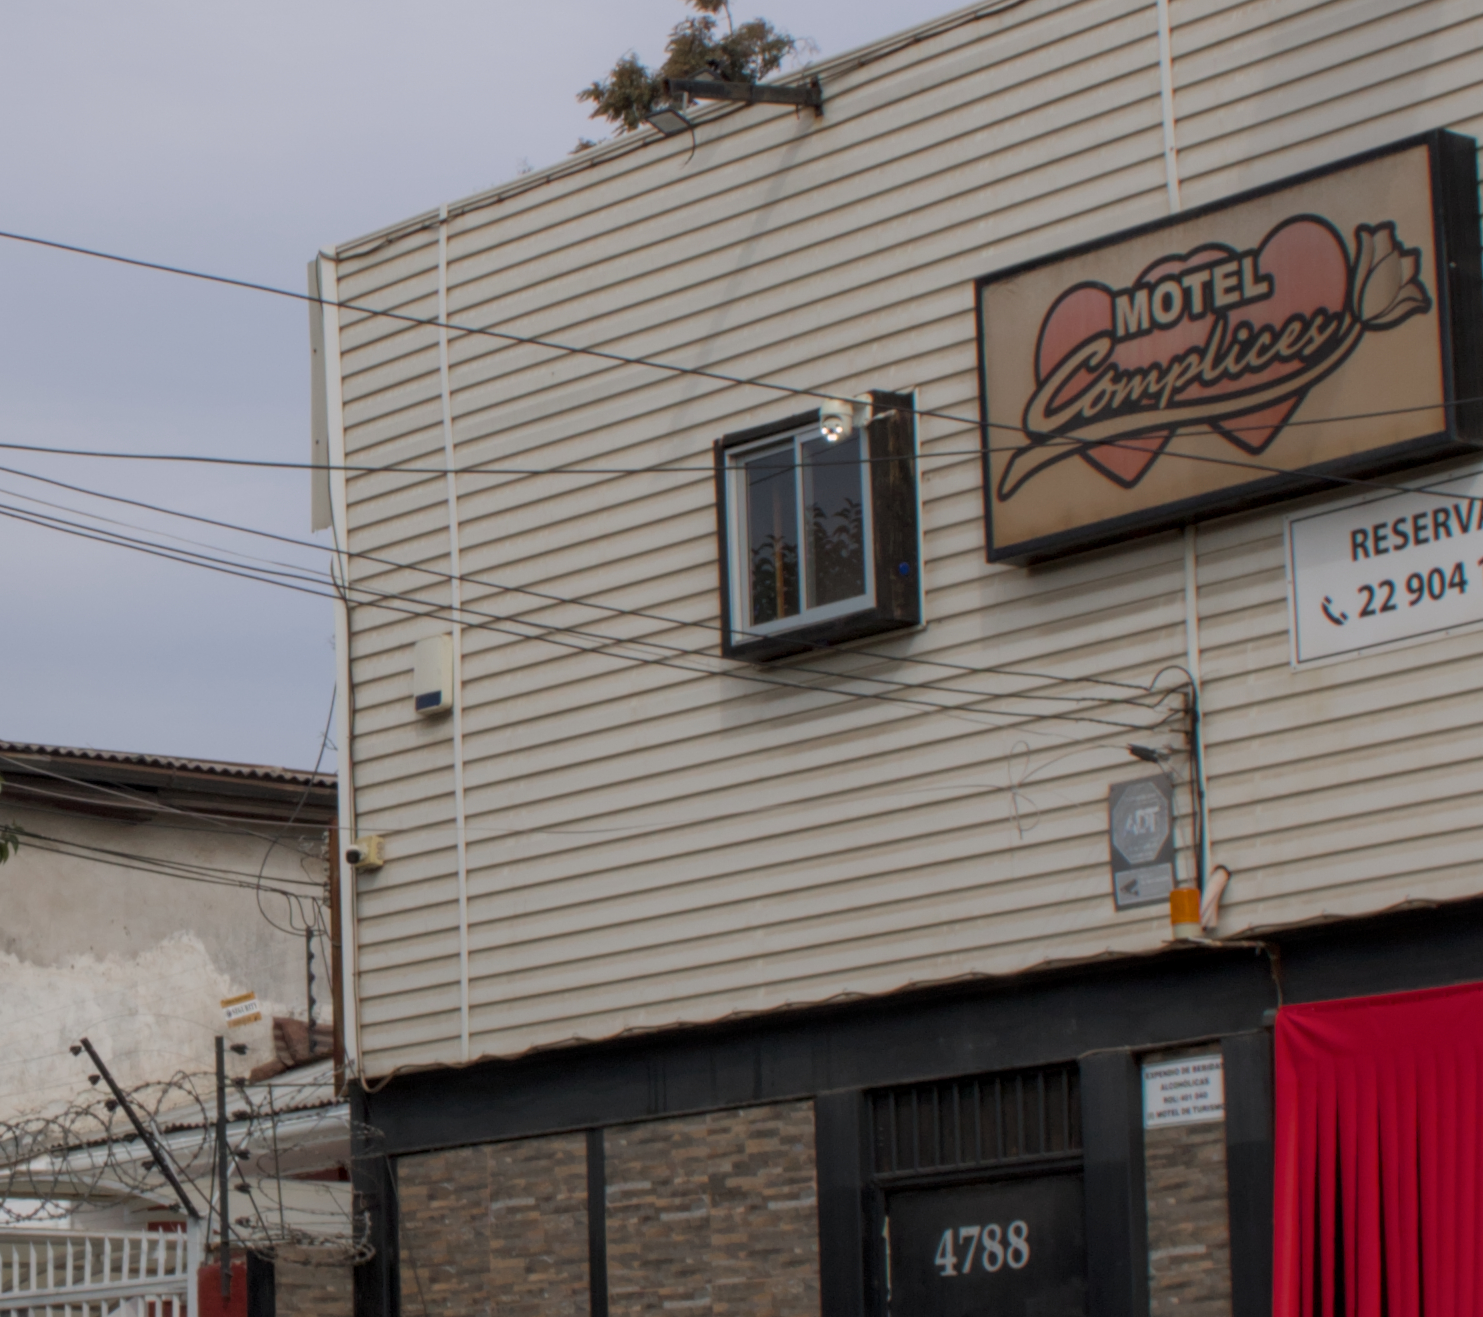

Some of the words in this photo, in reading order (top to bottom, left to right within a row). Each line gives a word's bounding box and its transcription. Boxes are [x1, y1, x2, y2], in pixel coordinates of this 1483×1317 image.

[1112, 257, 1272, 340] MOTEL
[1357, 583, 1398, 619] 22
[1406, 561, 1466, 605] 904
[1123, 805, 1161, 838] ADT
[1181, 1066, 1190, 1075] DE
[1156, 1108, 1179, 1118] MOTEL
[1181, 1106, 1190, 1115] DE
[934, 1219, 1030, 1277] 4788
